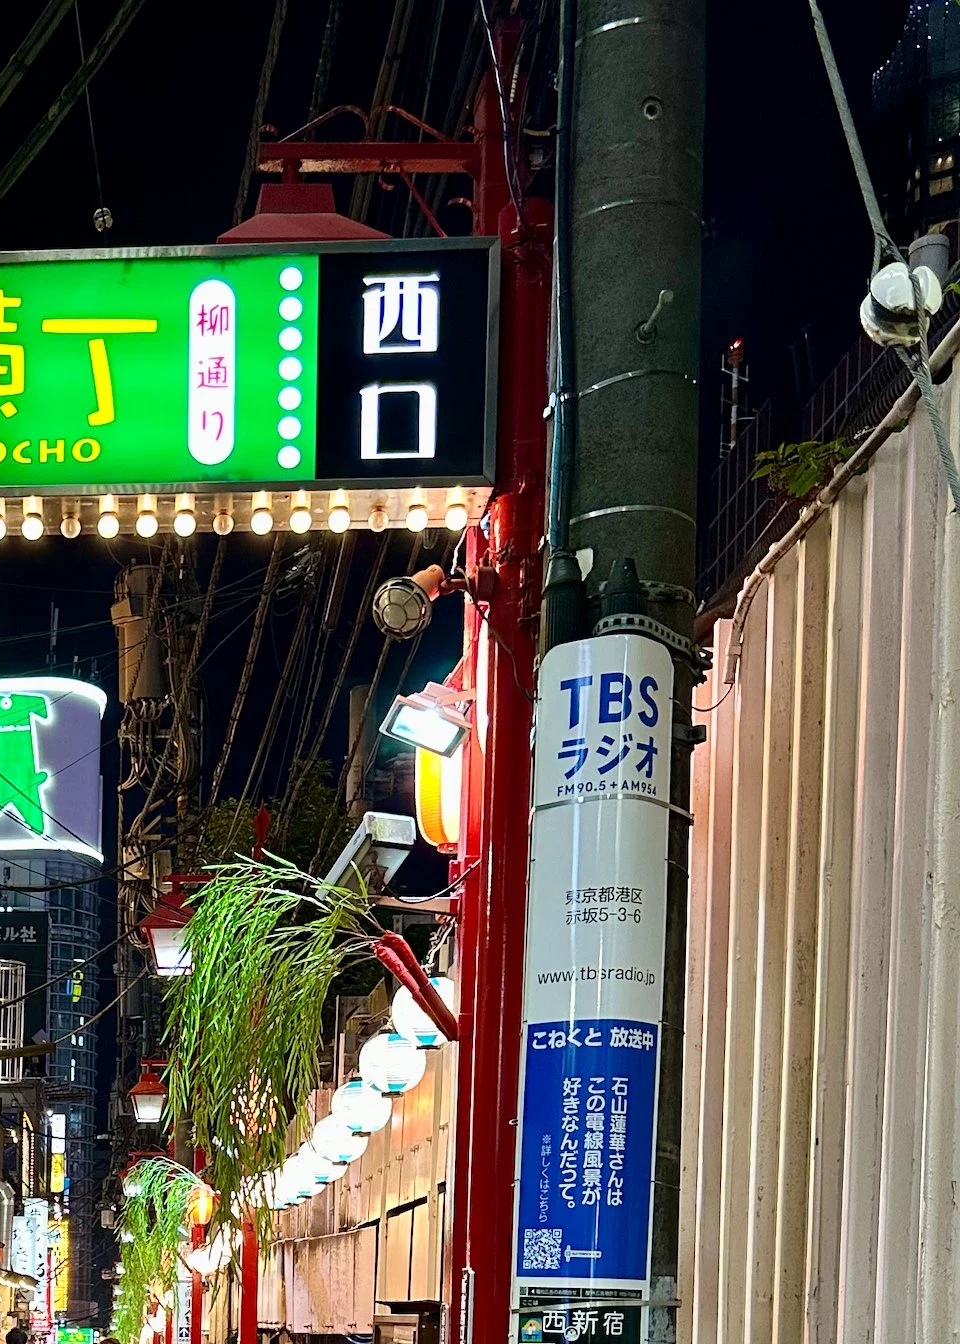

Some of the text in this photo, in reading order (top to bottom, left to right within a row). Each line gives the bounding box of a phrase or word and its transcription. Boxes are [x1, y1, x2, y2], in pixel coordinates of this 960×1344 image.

[196, 304, 230, 442] 柳通り
[360, 272, 440, 461] 西口
[560, 672, 659, 730] TBS
[557, 733, 658, 780] ラジオ
[565, 886, 643, 905] 東京都港区
[538, 965, 655, 987] www.tbsradio.jp
[532, 1026, 654, 1051] こねくと 放送中
[558, 1076, 582, 1209] 好きなんだって。
[582, 1076, 606, 1206] この電線風景が
[607, 1076, 629, 1207] 石山蓮華さんは
[542, 1309, 625, 1336] 西新宿
